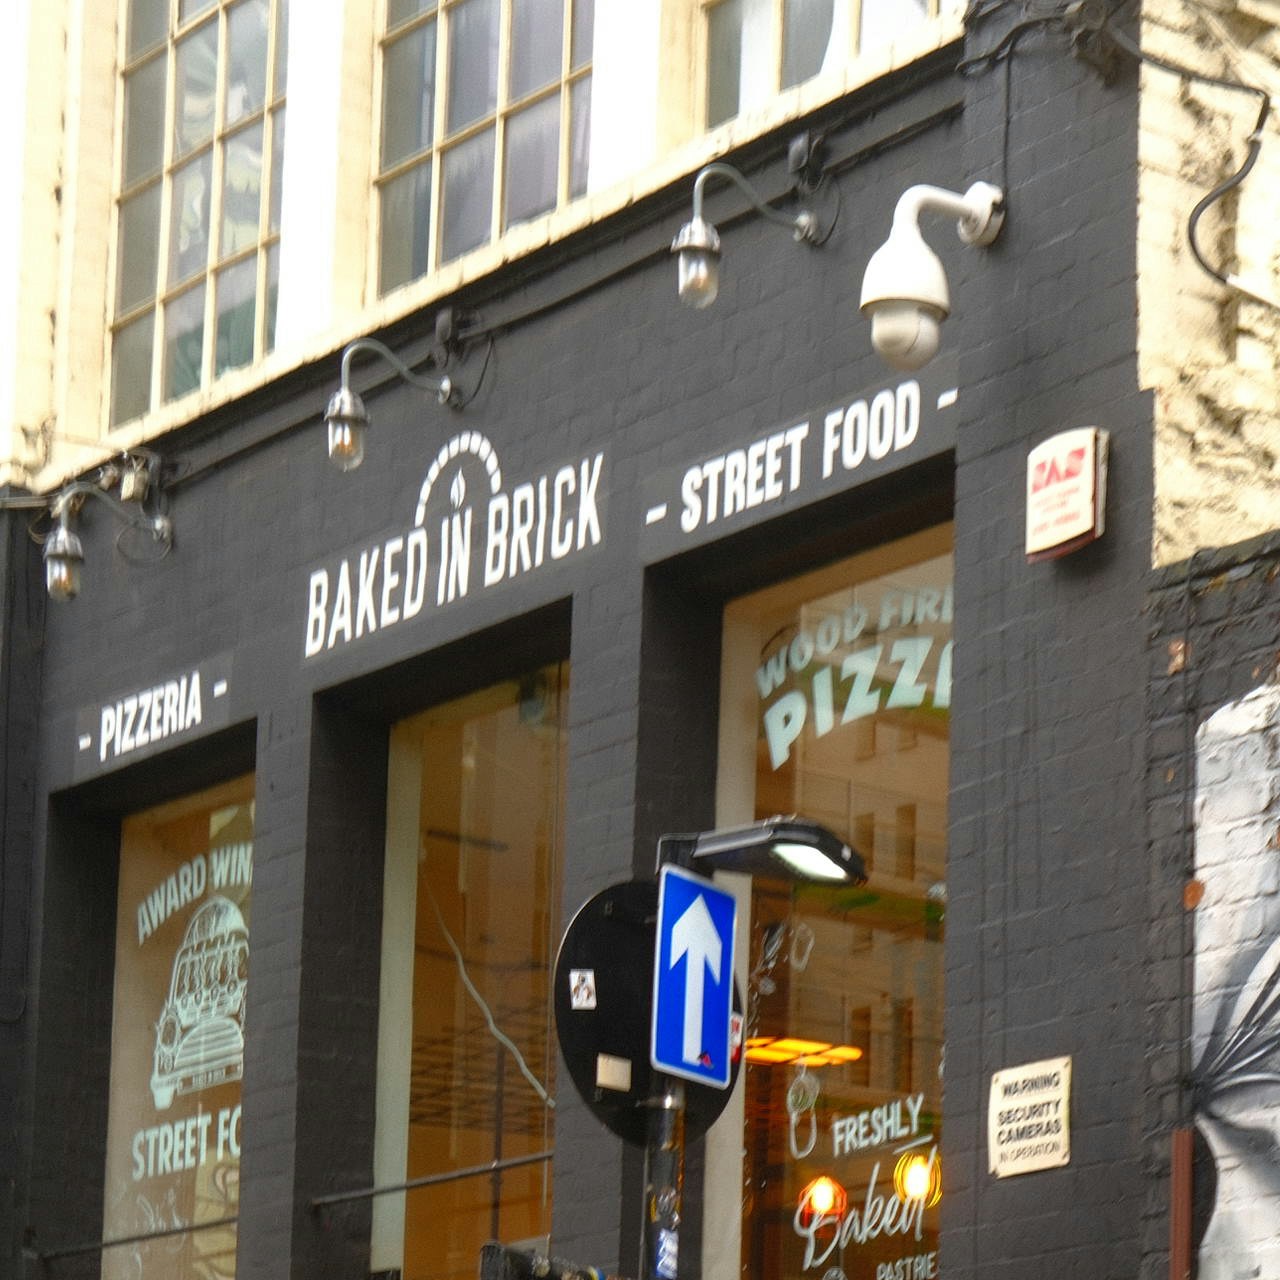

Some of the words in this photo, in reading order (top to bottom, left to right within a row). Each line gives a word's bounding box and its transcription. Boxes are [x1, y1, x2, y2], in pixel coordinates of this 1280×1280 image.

[680, 421, 810, 533] STREET
[822, 380, 921, 479] FOOD
[304, 527, 428, 658] BAKED
[436, 507, 473, 606] IN
[484, 452, 604, 588] BRICK
[755, 601, 869, 700] WOOD
[879, 586, 953, 632] FIR
[99, 671, 202, 763] PIZZERIA
[138, 853, 207, 948] AWARD
[212, 841, 254, 890] WIN
[833, 1092, 924, 1158] FRESHLY
[998, 1098, 1061, 1127] SECURITY
[1002, 1071, 1060, 1098] WARNING
[132, 1112, 212, 1182] STREET
[997, 1118, 1061, 1146] CAMERAS
[793, 1144, 937, 1271] Baked
